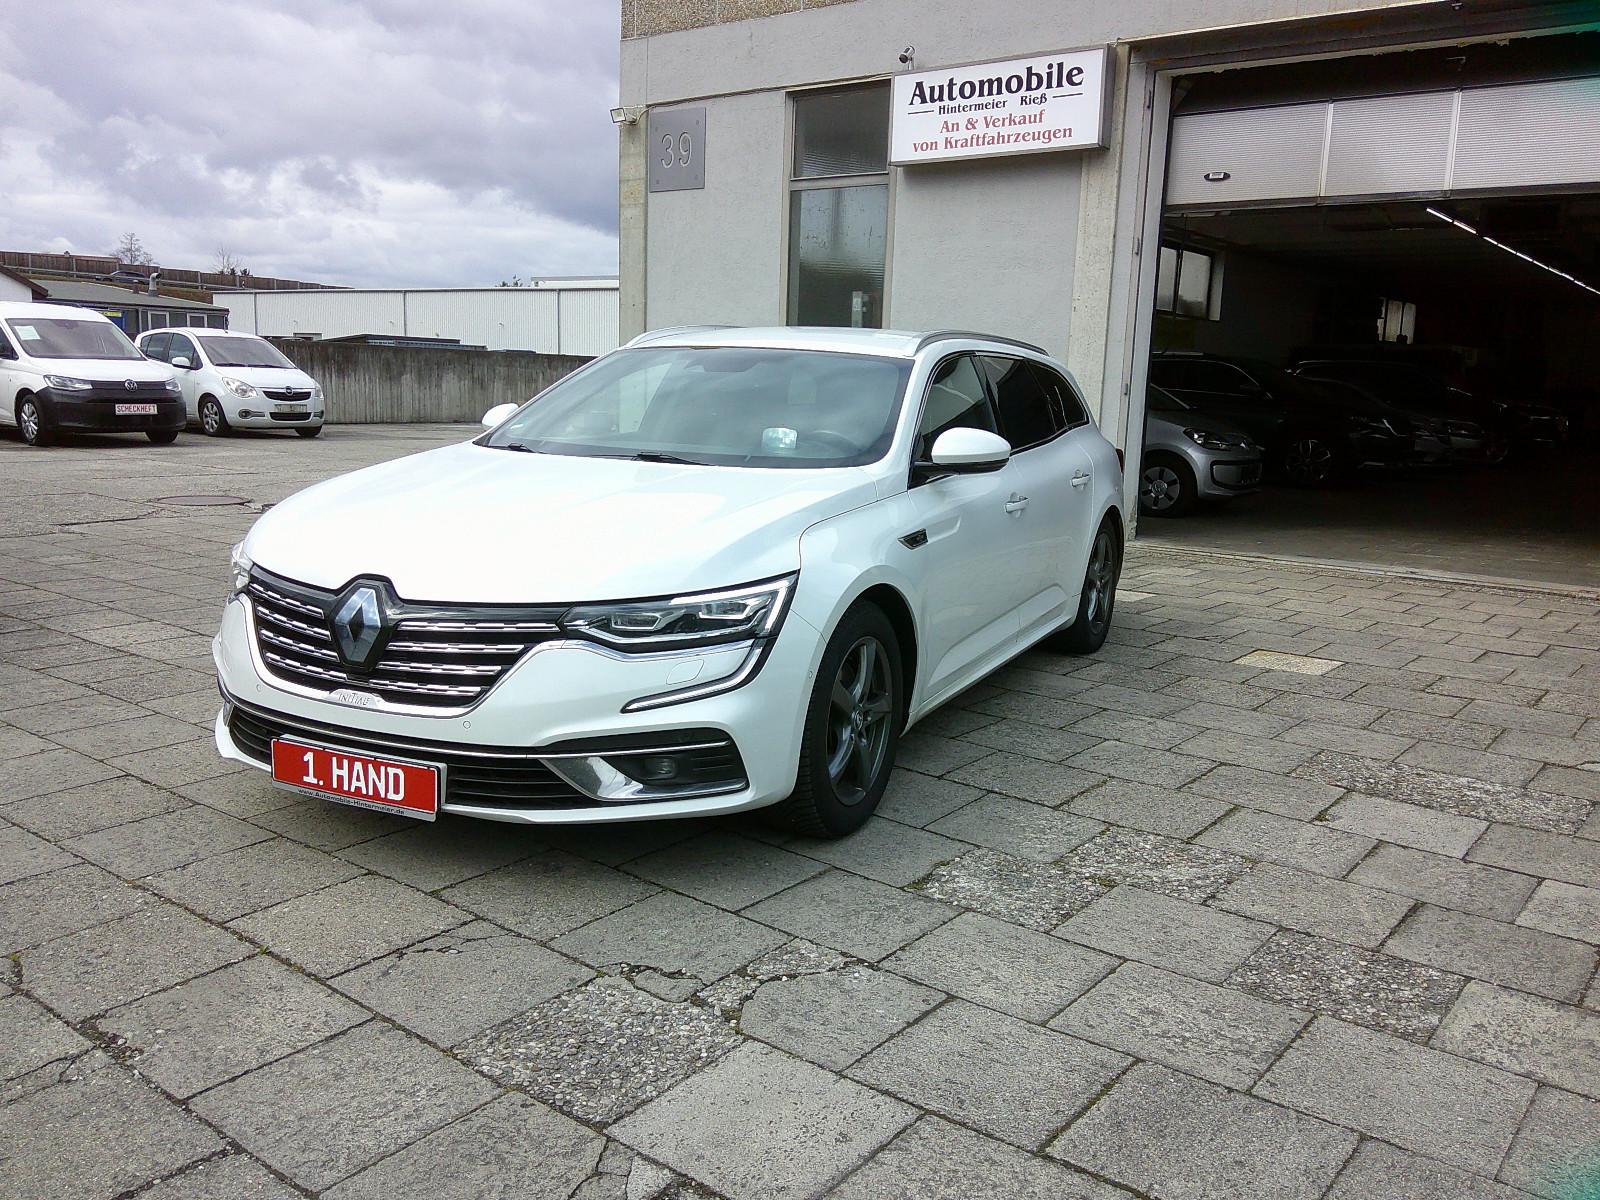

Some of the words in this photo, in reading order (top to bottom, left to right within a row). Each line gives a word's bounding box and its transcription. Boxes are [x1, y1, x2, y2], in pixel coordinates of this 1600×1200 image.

[909, 61, 1084, 106] Automobile
[938, 99, 1008, 115] Hintermeier
[1020, 93, 1047, 106] Rieß
[940, 120, 960, 134] An
[965, 117, 979, 130] &
[983, 109, 1046, 129] Verkauf
[661, 131, 692, 168] 39
[913, 139, 938, 153] von
[944, 127, 1073, 150] Kraftfahrzeugen
[116, 405, 156, 413] SCHECKHEFT
[302, 751, 324, 786] 1.
[331, 756, 405, 801] HAND
[297, 788, 405, 815] www.Automobile-Hintermeier.de
